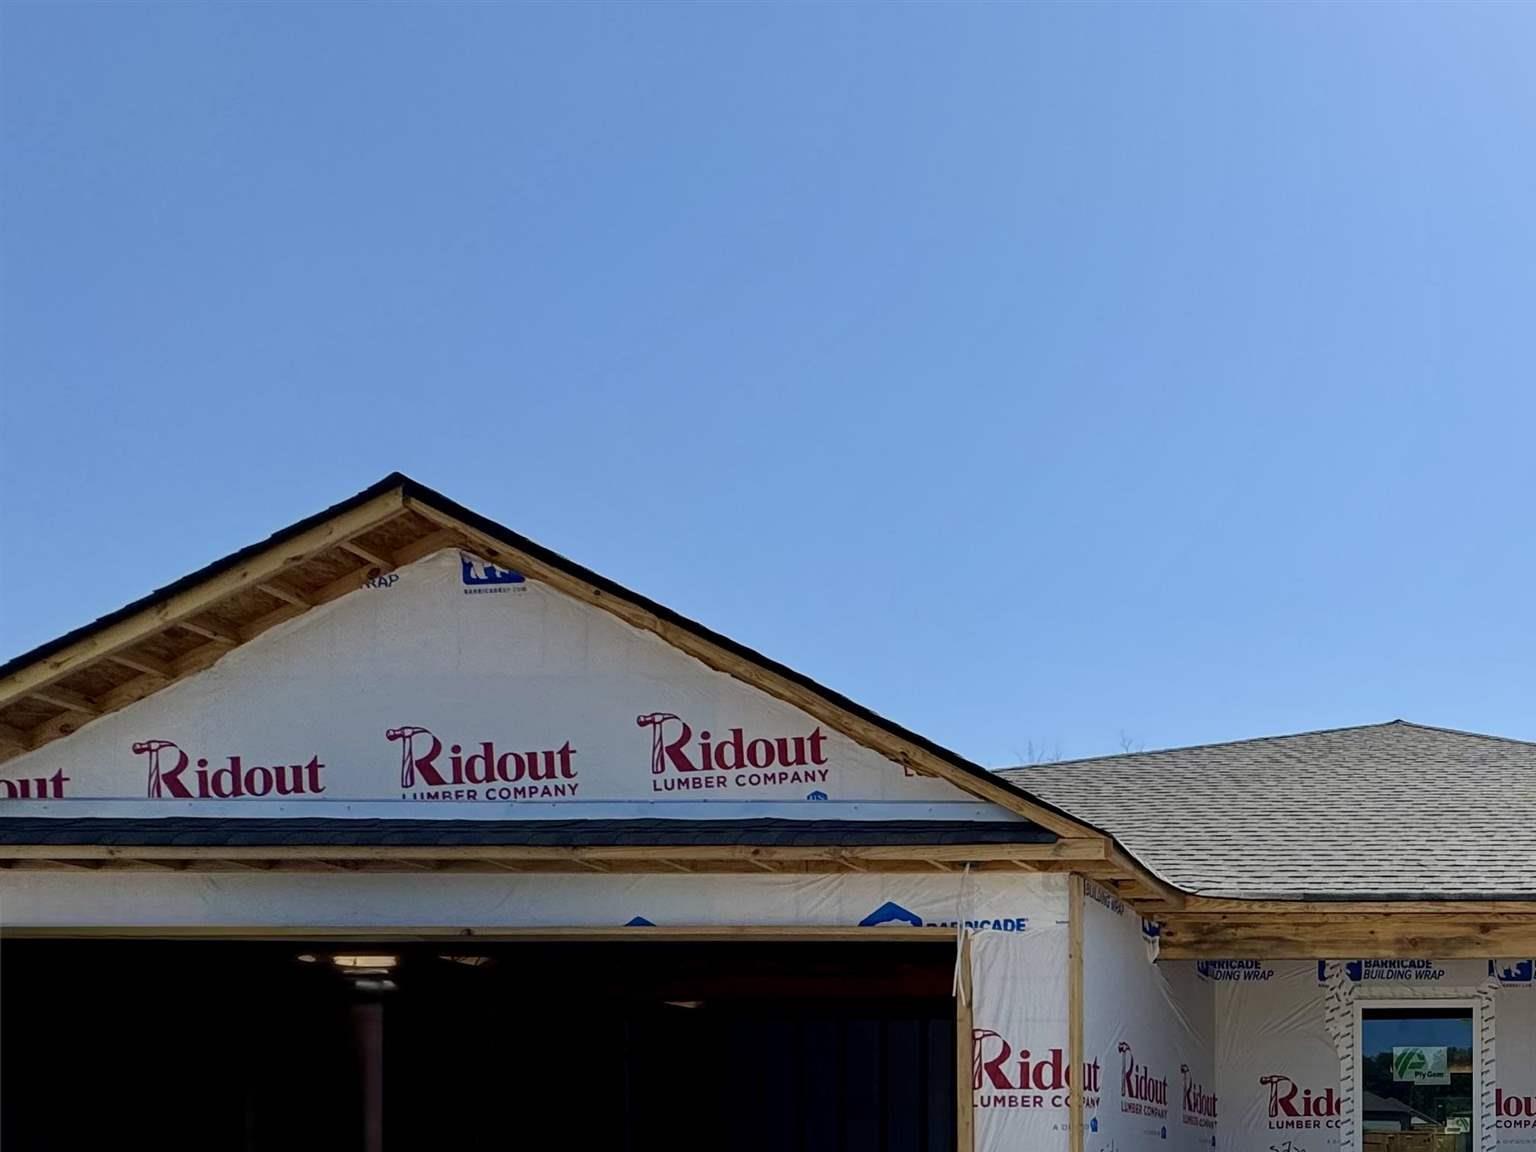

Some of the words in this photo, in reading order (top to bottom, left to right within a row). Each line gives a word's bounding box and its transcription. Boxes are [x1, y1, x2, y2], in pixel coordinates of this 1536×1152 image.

[362, 573, 400, 589] RAP
[637, 712, 828, 775] Ridout
[386, 726, 578, 788] Ridout
[132, 739, 326, 799] Ridout
[0, 768, 70, 799] out
[653, 778, 727, 792] LUMBER
[735, 769, 829, 787] COMPANY
[485, 783, 579, 800] COMPANY
[1363, 969, 1411, 980] BUILDING
[1414, 970, 1445, 980] WRAP
[1364, 960, 1432, 969] BARRICADE
[1243, 970, 1274, 981] WRAP
[1118, 1041, 1168, 1106] Ridout
[1269, 1120, 1321, 1129] LUMBER
